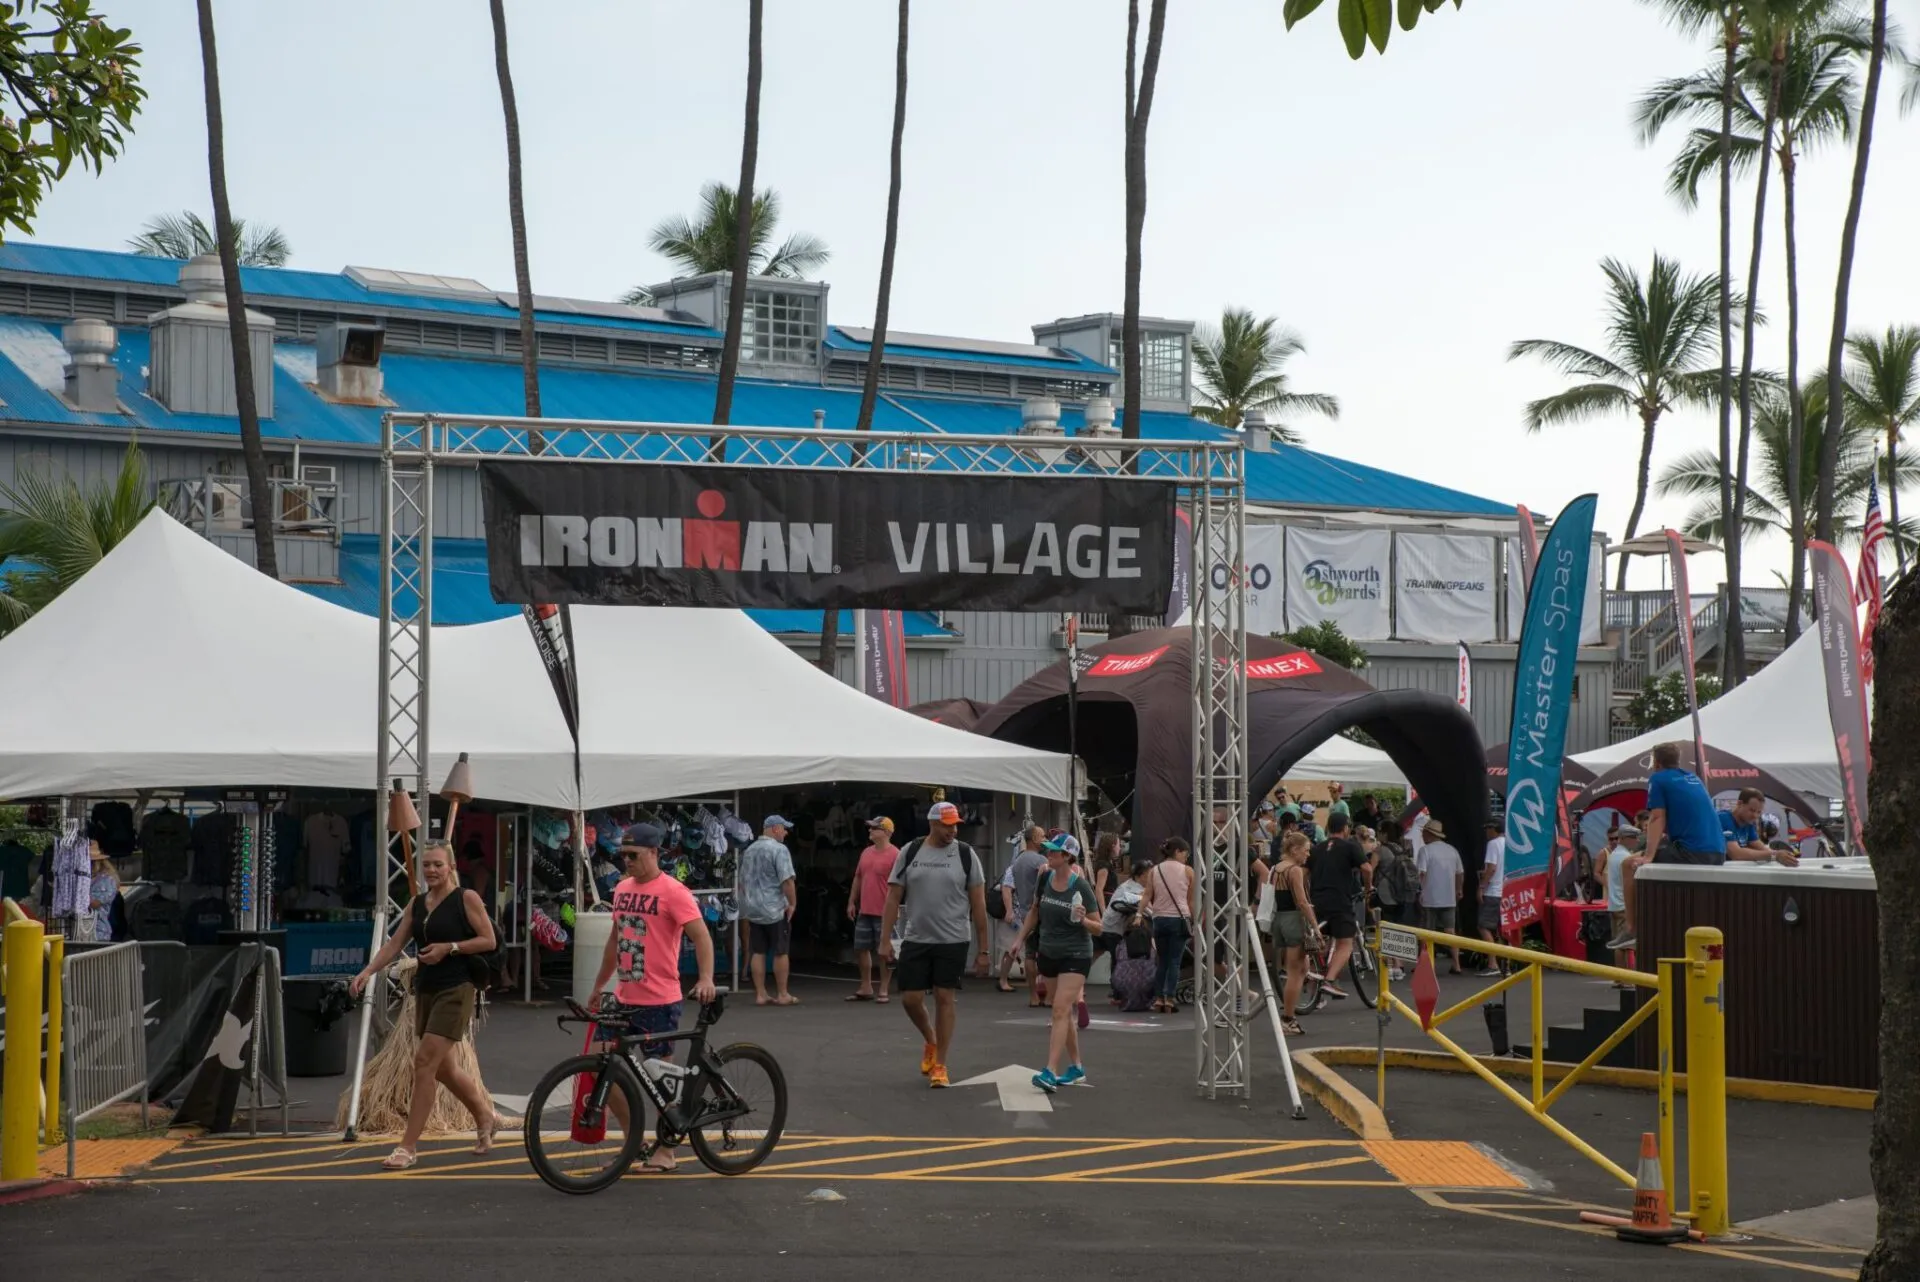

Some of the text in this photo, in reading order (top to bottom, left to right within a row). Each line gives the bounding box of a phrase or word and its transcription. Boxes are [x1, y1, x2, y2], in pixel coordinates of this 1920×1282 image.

[887, 521, 1141, 578] VILLAGE
[1404, 579, 1485, 591] TRAININGPEAKS
[1103, 652, 1159, 671] TIMEX
[1526, 549, 1574, 769] Master Spas
[614, 892, 659, 916] OSAKA
[1519, 887, 1536, 905] IN
[1513, 903, 1538, 922] USA
[311, 948, 364, 965] IRON
[628, 1054, 658, 1096] ARGON
